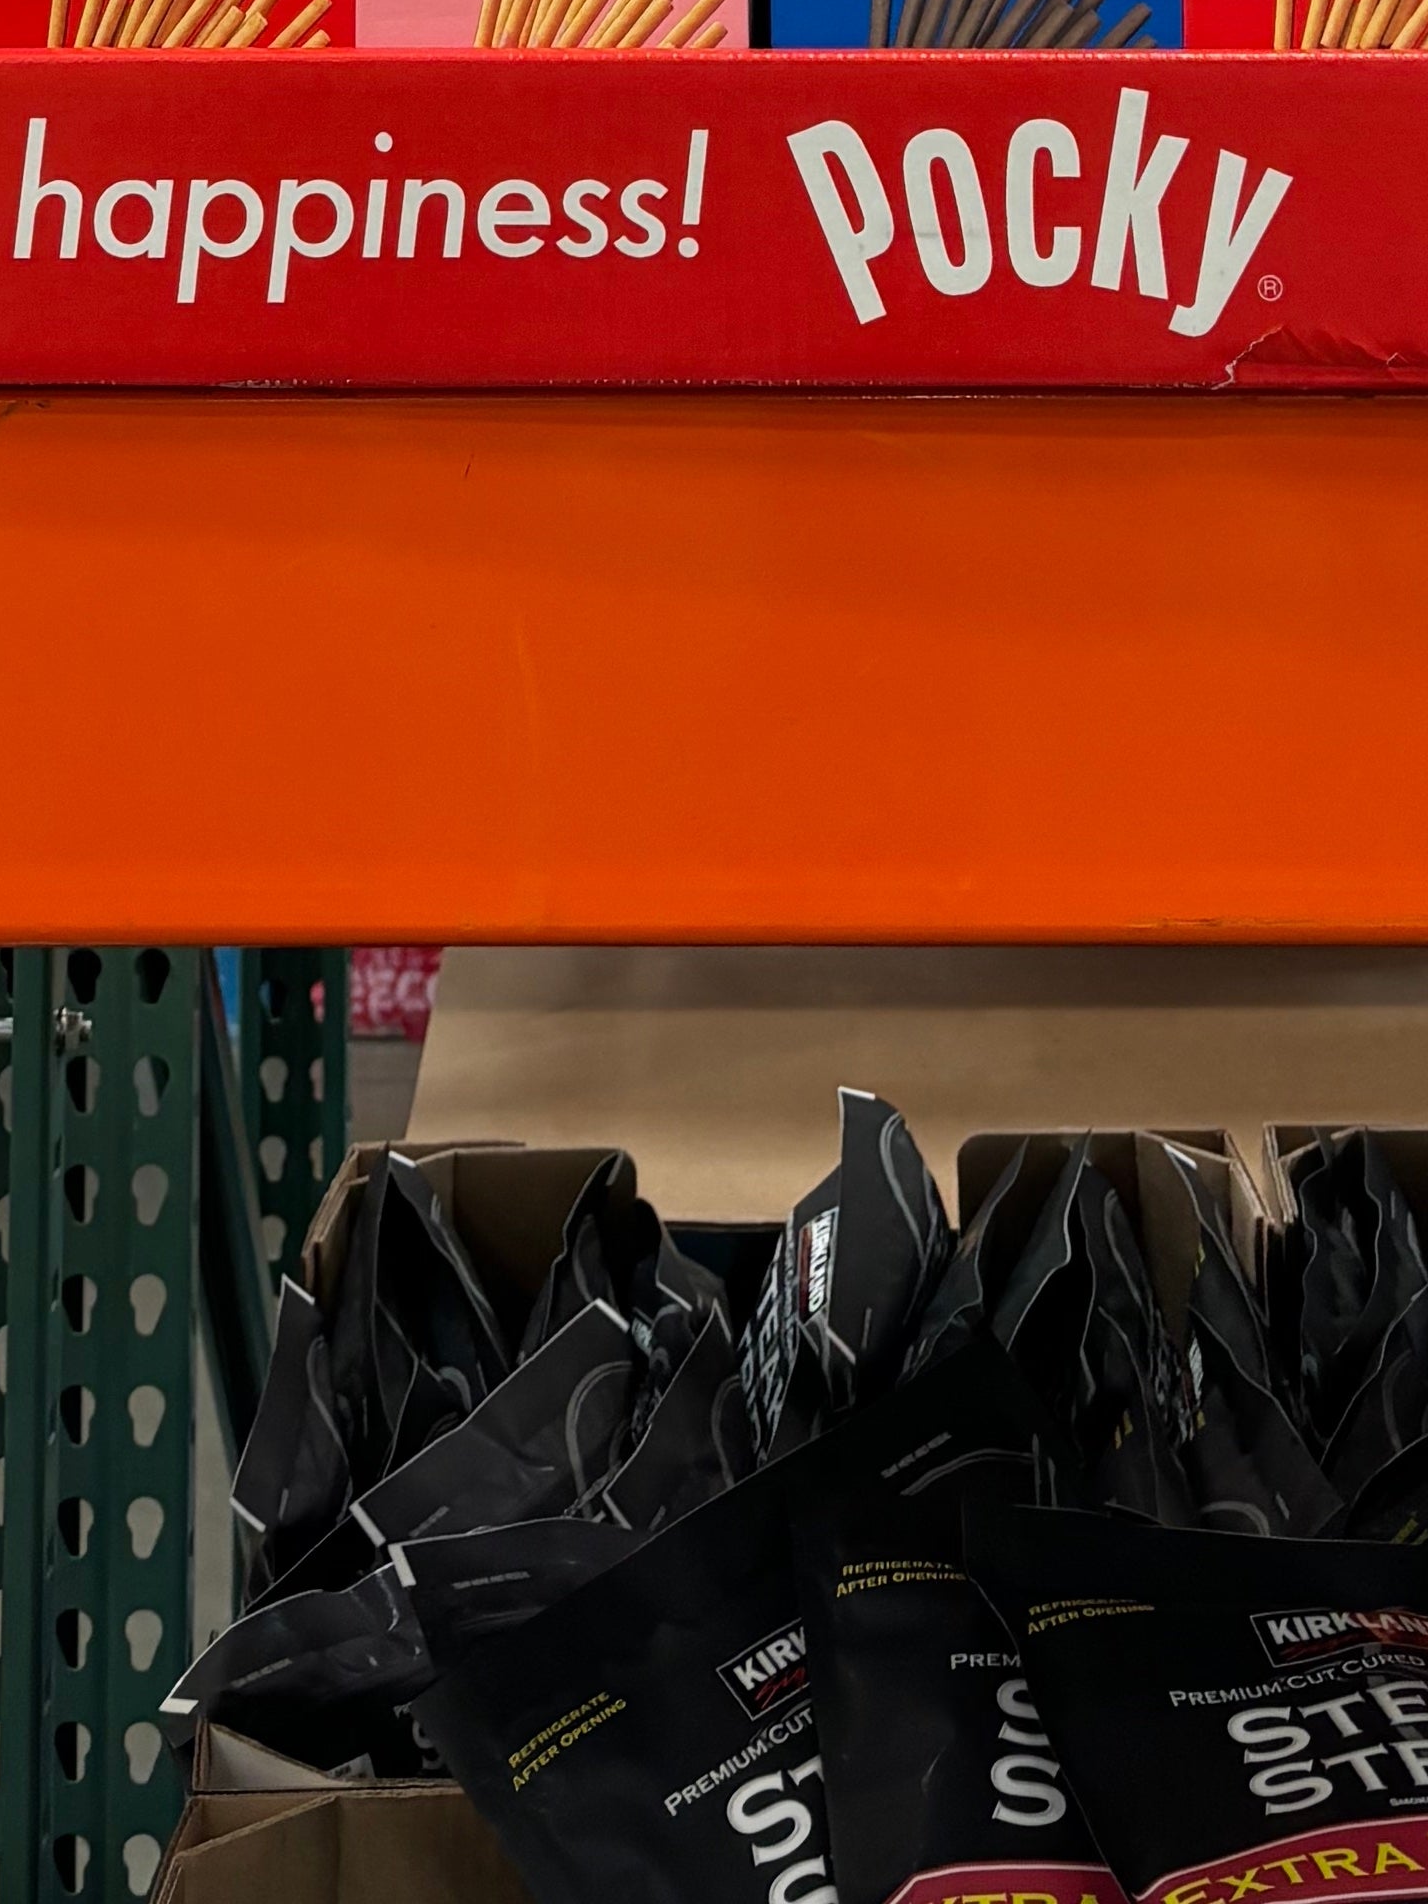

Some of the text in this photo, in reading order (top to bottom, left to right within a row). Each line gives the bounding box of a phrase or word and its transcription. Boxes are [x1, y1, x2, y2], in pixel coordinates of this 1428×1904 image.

[13, 117, 709, 304] happiness!
[786, 87, 1294, 337] Pocky
[1341, 1652, 1427, 1676] CURED
[508, 1692, 610, 1769] REFRIGERATE
[512, 1698, 628, 1792] AFTER OPENING
[663, 1740, 767, 1817] PREMIUM
[1162, 1841, 1425, 1904] EXTRA
